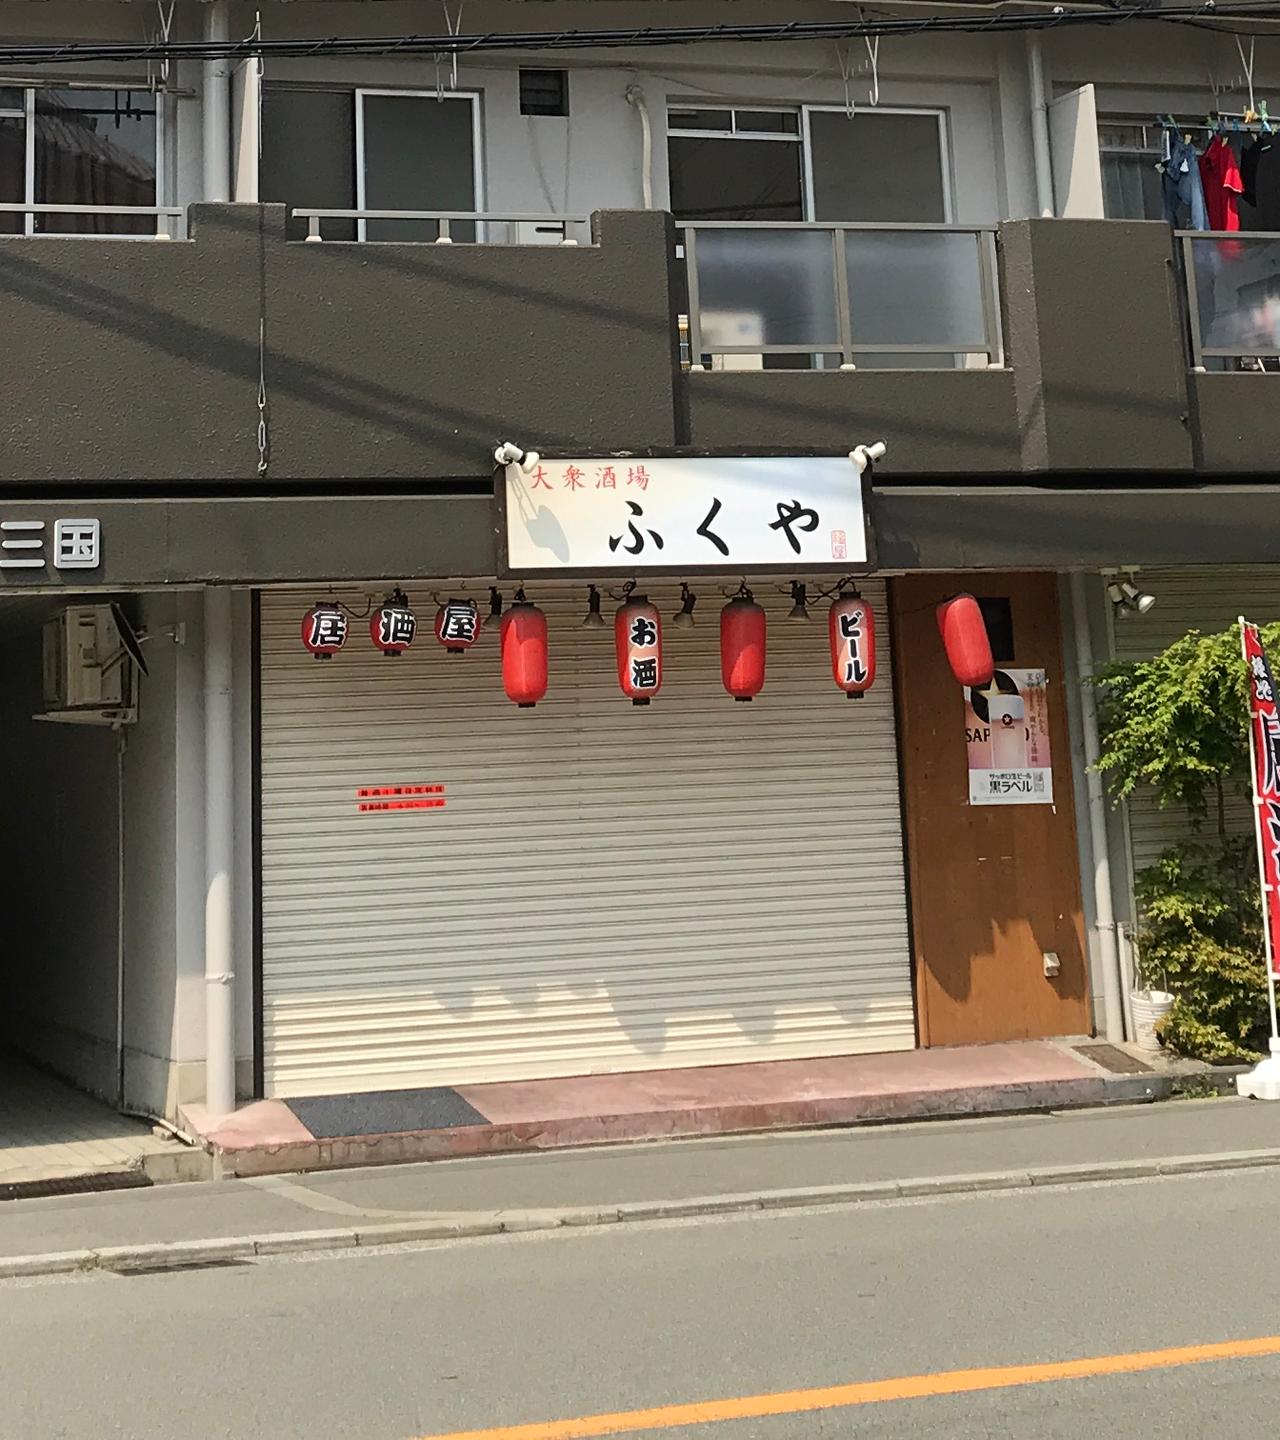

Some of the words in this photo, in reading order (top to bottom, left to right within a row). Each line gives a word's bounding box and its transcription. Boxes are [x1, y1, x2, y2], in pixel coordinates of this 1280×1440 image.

[531, 465, 650, 491] 大衆酒場
[609, 497, 819, 556] ふくや
[310, 610, 348, 648] 居
[379, 609, 417, 647] 酒
[440, 606, 478, 642] 屋
[838, 610, 868, 684] ビール
[630, 617, 659, 689] お酒
[990, 781, 1033, 794] 黒ラベル
